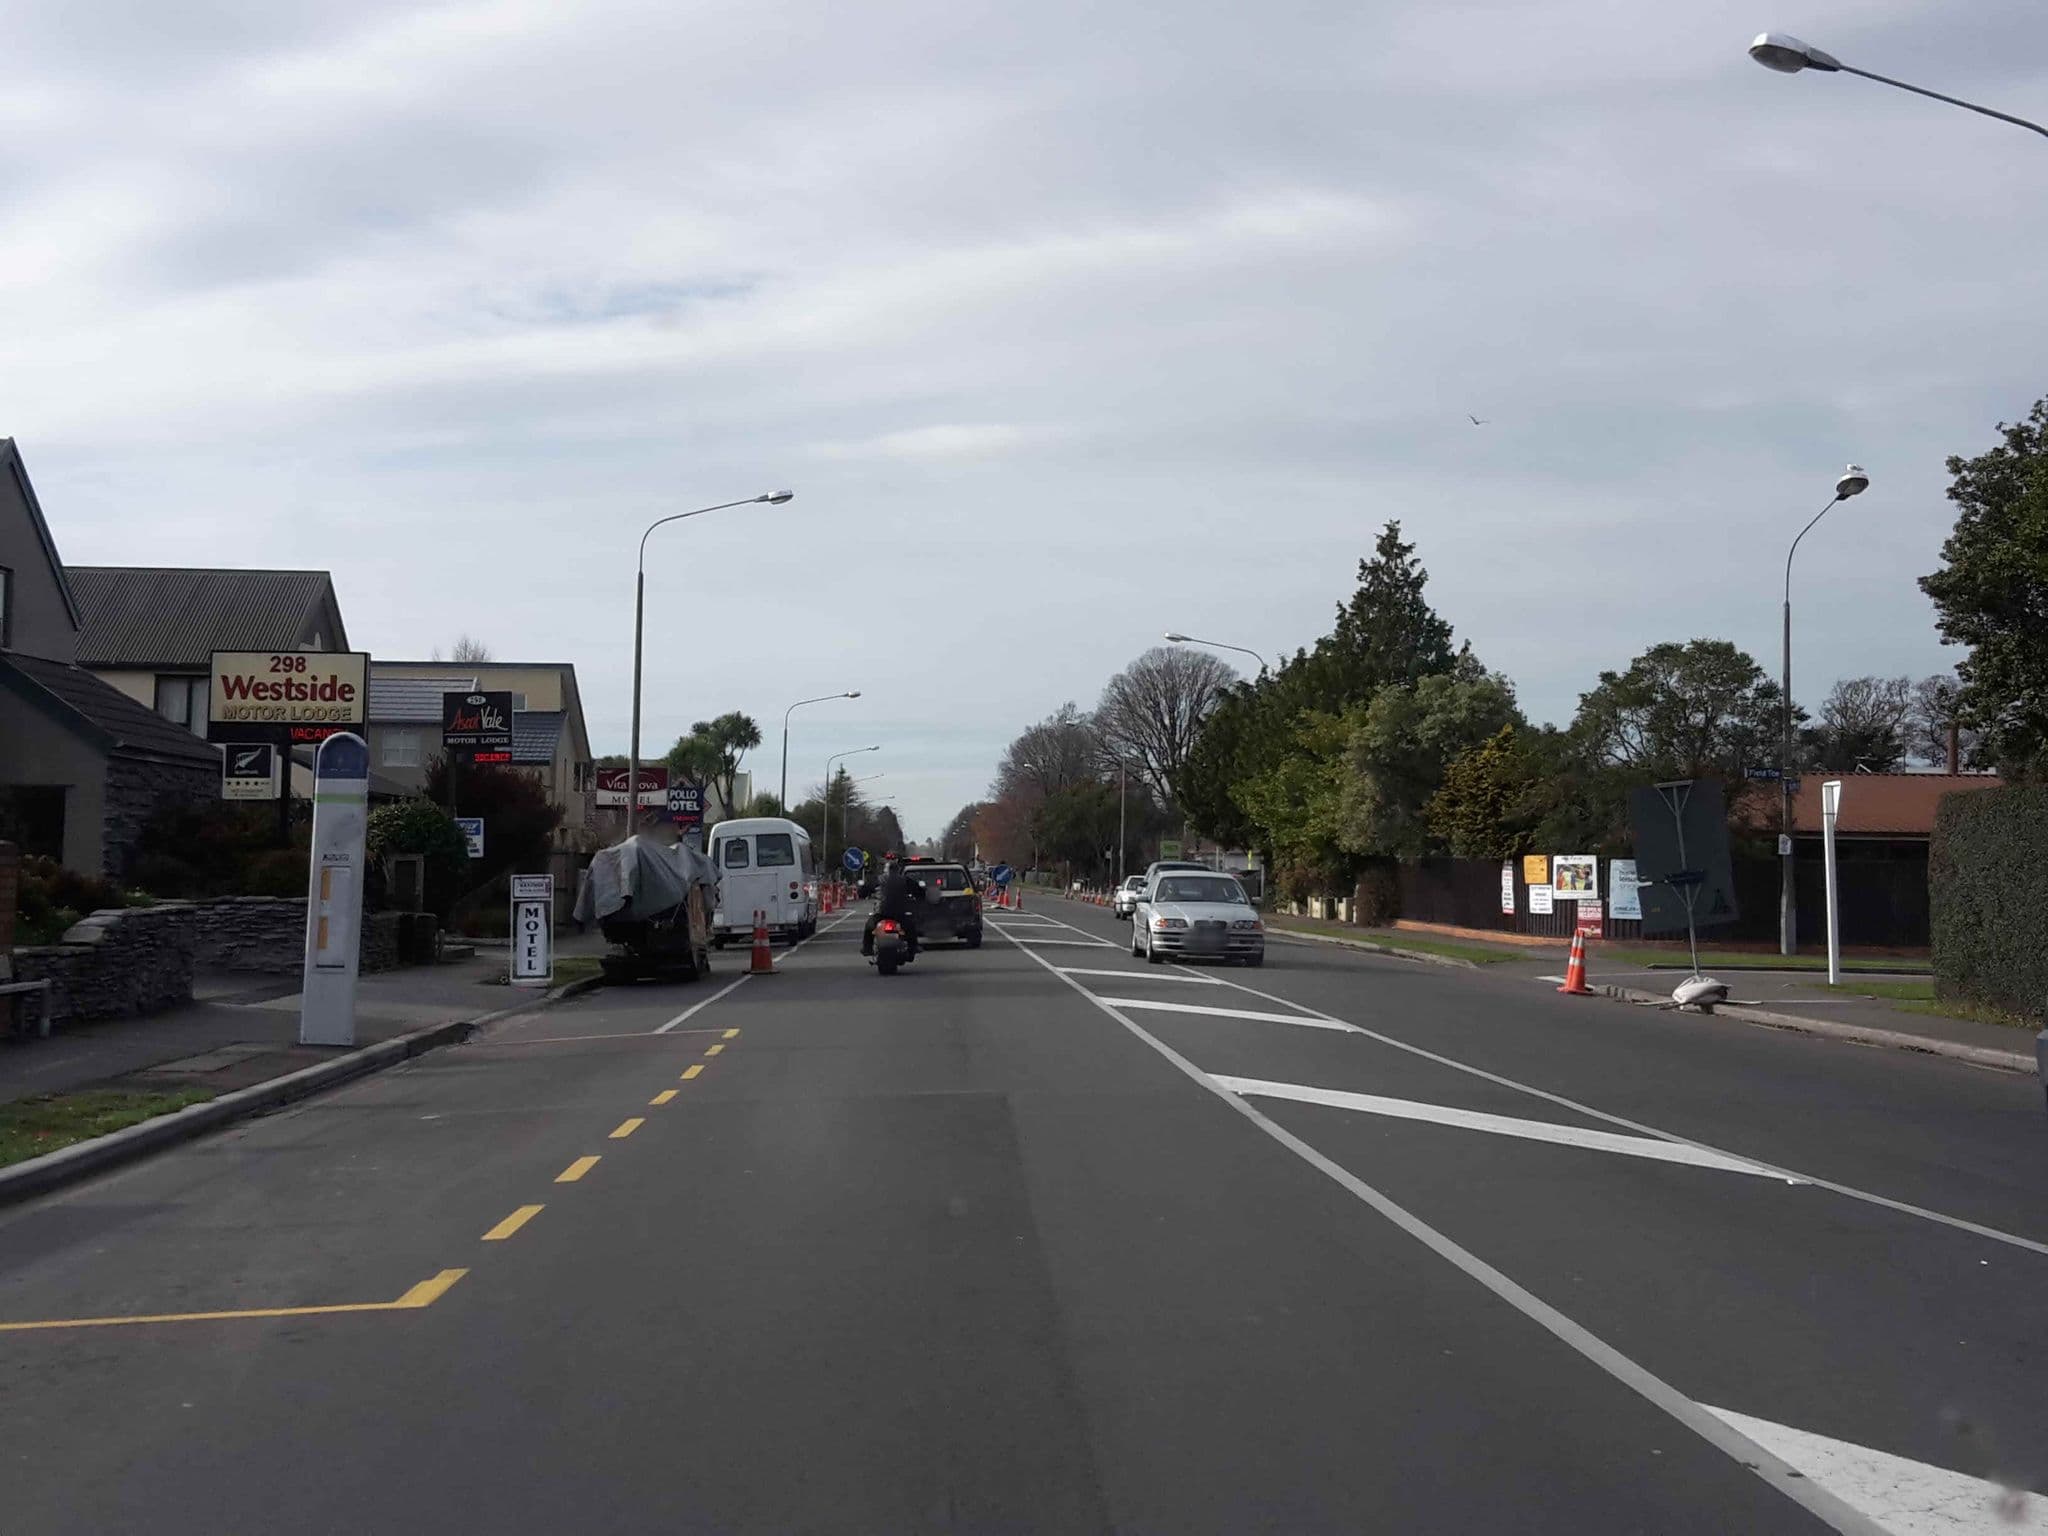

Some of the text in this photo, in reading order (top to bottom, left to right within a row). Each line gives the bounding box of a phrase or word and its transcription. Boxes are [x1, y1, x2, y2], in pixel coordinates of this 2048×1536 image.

[269, 655, 307, 673] 298
[220, 674, 356, 702] Westside
[223, 705, 353, 722] MOTOR LODGE
[480, 705, 509, 732] Vale
[289, 727, 349, 741] VACAN
[446, 736, 510, 745] MOTOR LODGE
[606, 779, 659, 790] Vita ova
[611, 795, 652, 804] MOEL
[669, 789, 698, 800] POLLO
[667, 801, 701, 811] OTEL
[525, 907, 540, 971] MOTEL
